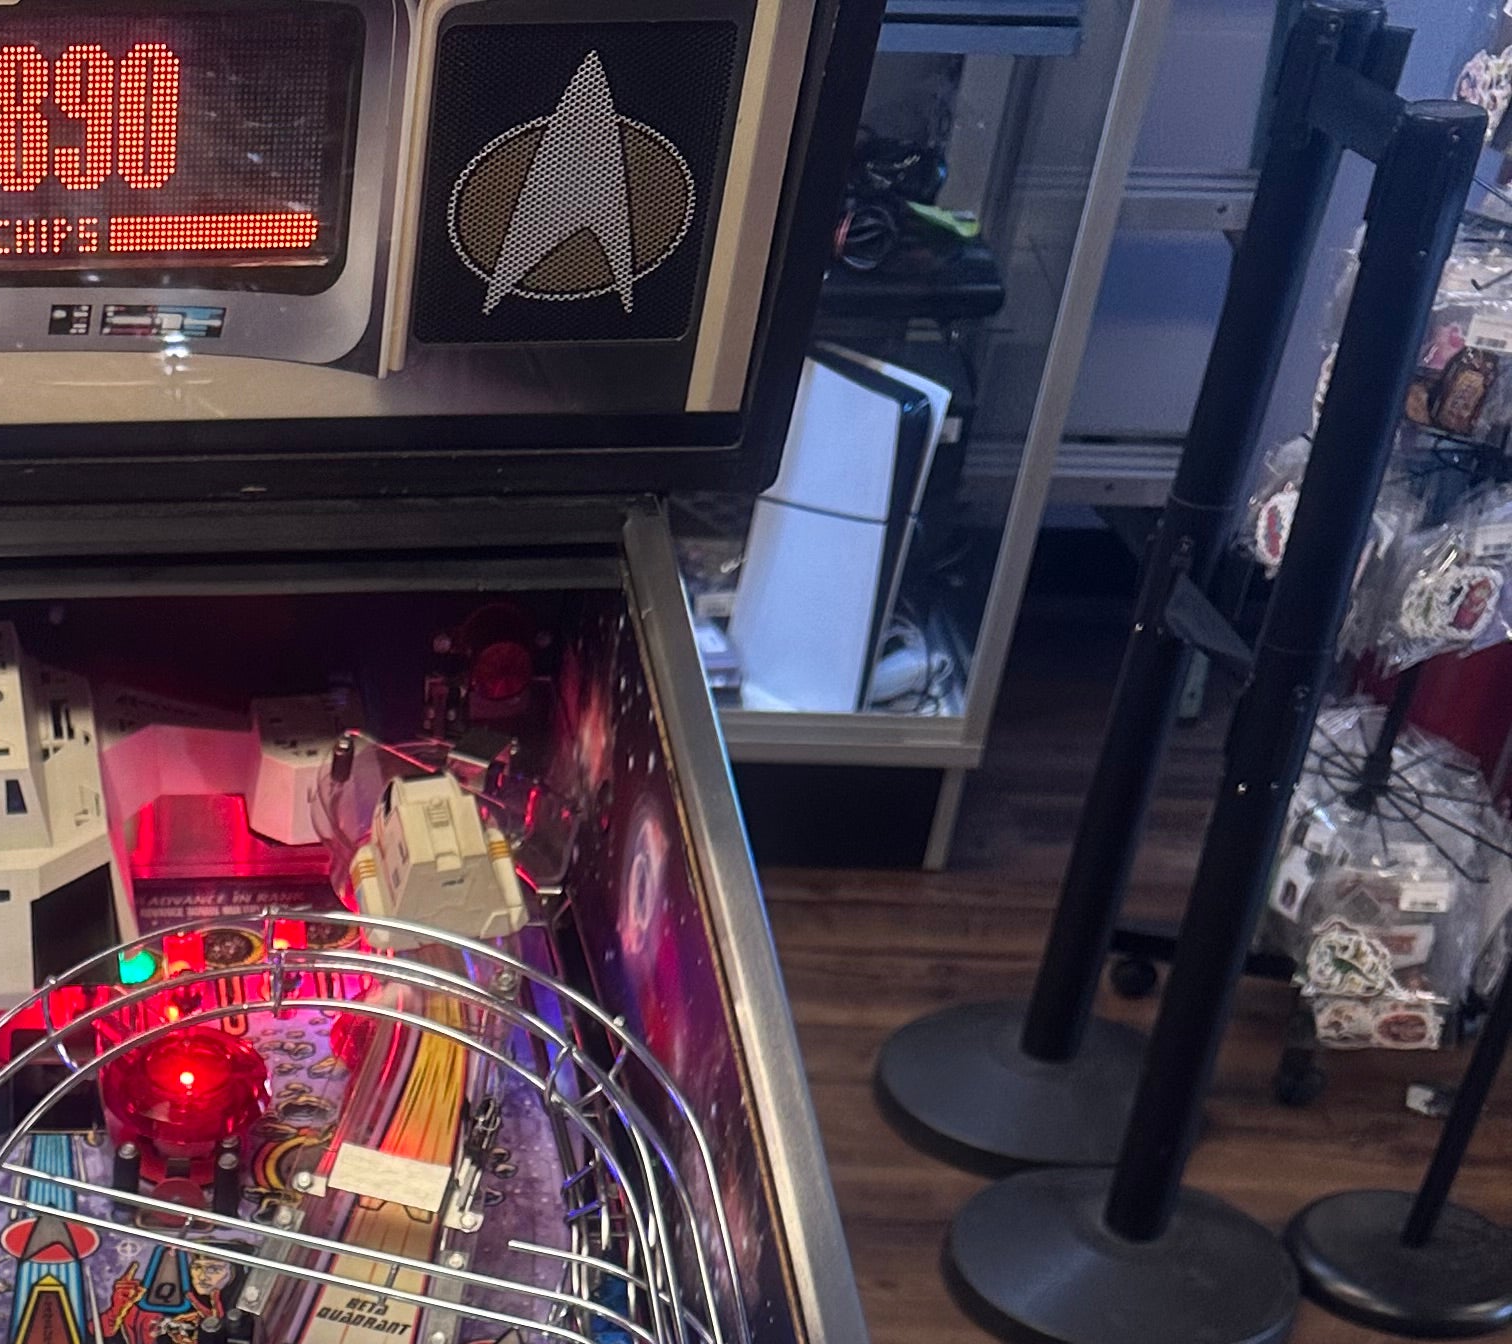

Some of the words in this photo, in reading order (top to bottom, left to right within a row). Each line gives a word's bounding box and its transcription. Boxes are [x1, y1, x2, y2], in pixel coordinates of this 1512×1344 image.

[155, 1282, 176, 1301] Q
[346, 1298, 389, 1316] BETA
[316, 1307, 412, 1337] QUADRANT
